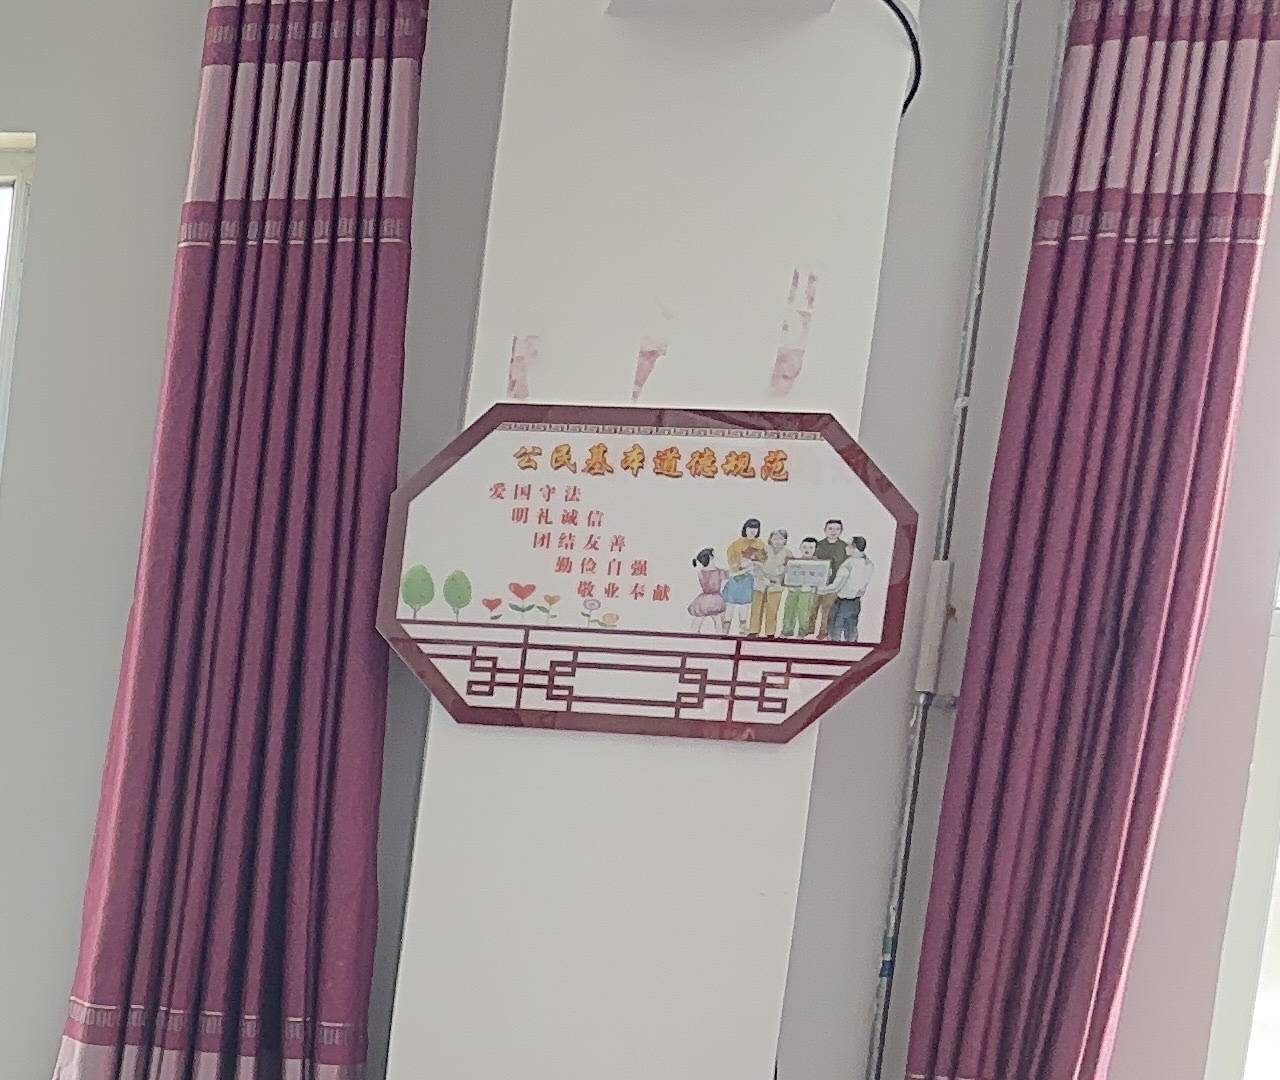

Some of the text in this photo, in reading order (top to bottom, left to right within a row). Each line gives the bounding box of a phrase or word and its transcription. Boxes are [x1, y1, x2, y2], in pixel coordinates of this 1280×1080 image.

[513, 442, 789, 482] 公民基本道德规范
[489, 482, 581, 502] 爱国守法
[512, 507, 604, 527] 明礼诚信
[533, 532, 626, 552] 团结友善
[555, 556, 648, 576] 勤俭自强
[577, 581, 671, 601] 敬业奉献
